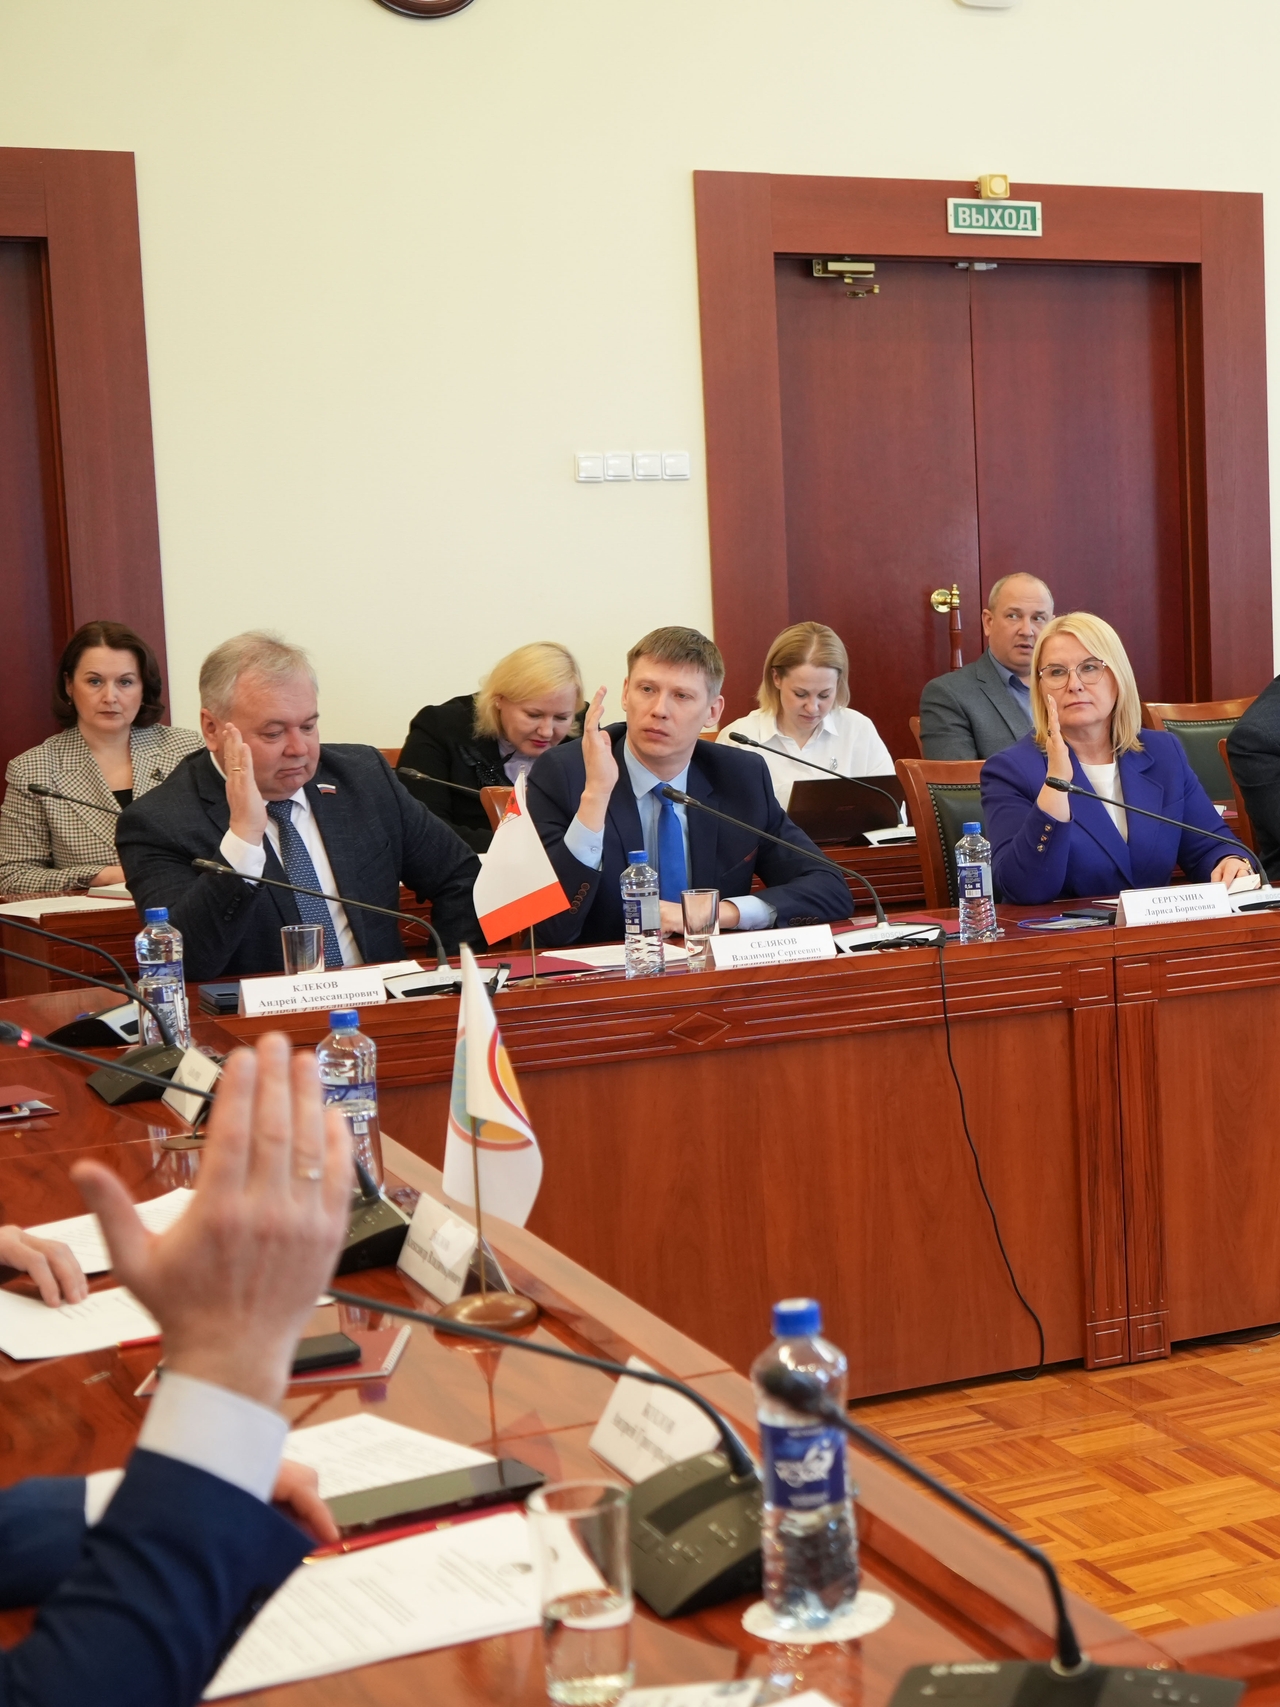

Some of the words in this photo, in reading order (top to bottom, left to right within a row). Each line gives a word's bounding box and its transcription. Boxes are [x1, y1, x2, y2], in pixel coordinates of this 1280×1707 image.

[957, 207, 1032, 230] ВЫХОД
[1151, 893, 1204, 905] СЕРГУХИНА
[1144, 907, 1174, 917] Лариса
[1175, 903, 1216, 913] Борисовна
[750, 937, 798, 949] СЕЛЯКОВ
[731, 951, 777, 963] Владимир
[777, 947, 822, 959] Сергеевич
[439, 975, 462, 983] BOSC
[292, 981, 339, 993] КЛЕКОВ
[258, 996, 297, 1009] Андрей
[299, 989, 380, 1005] Александрович
